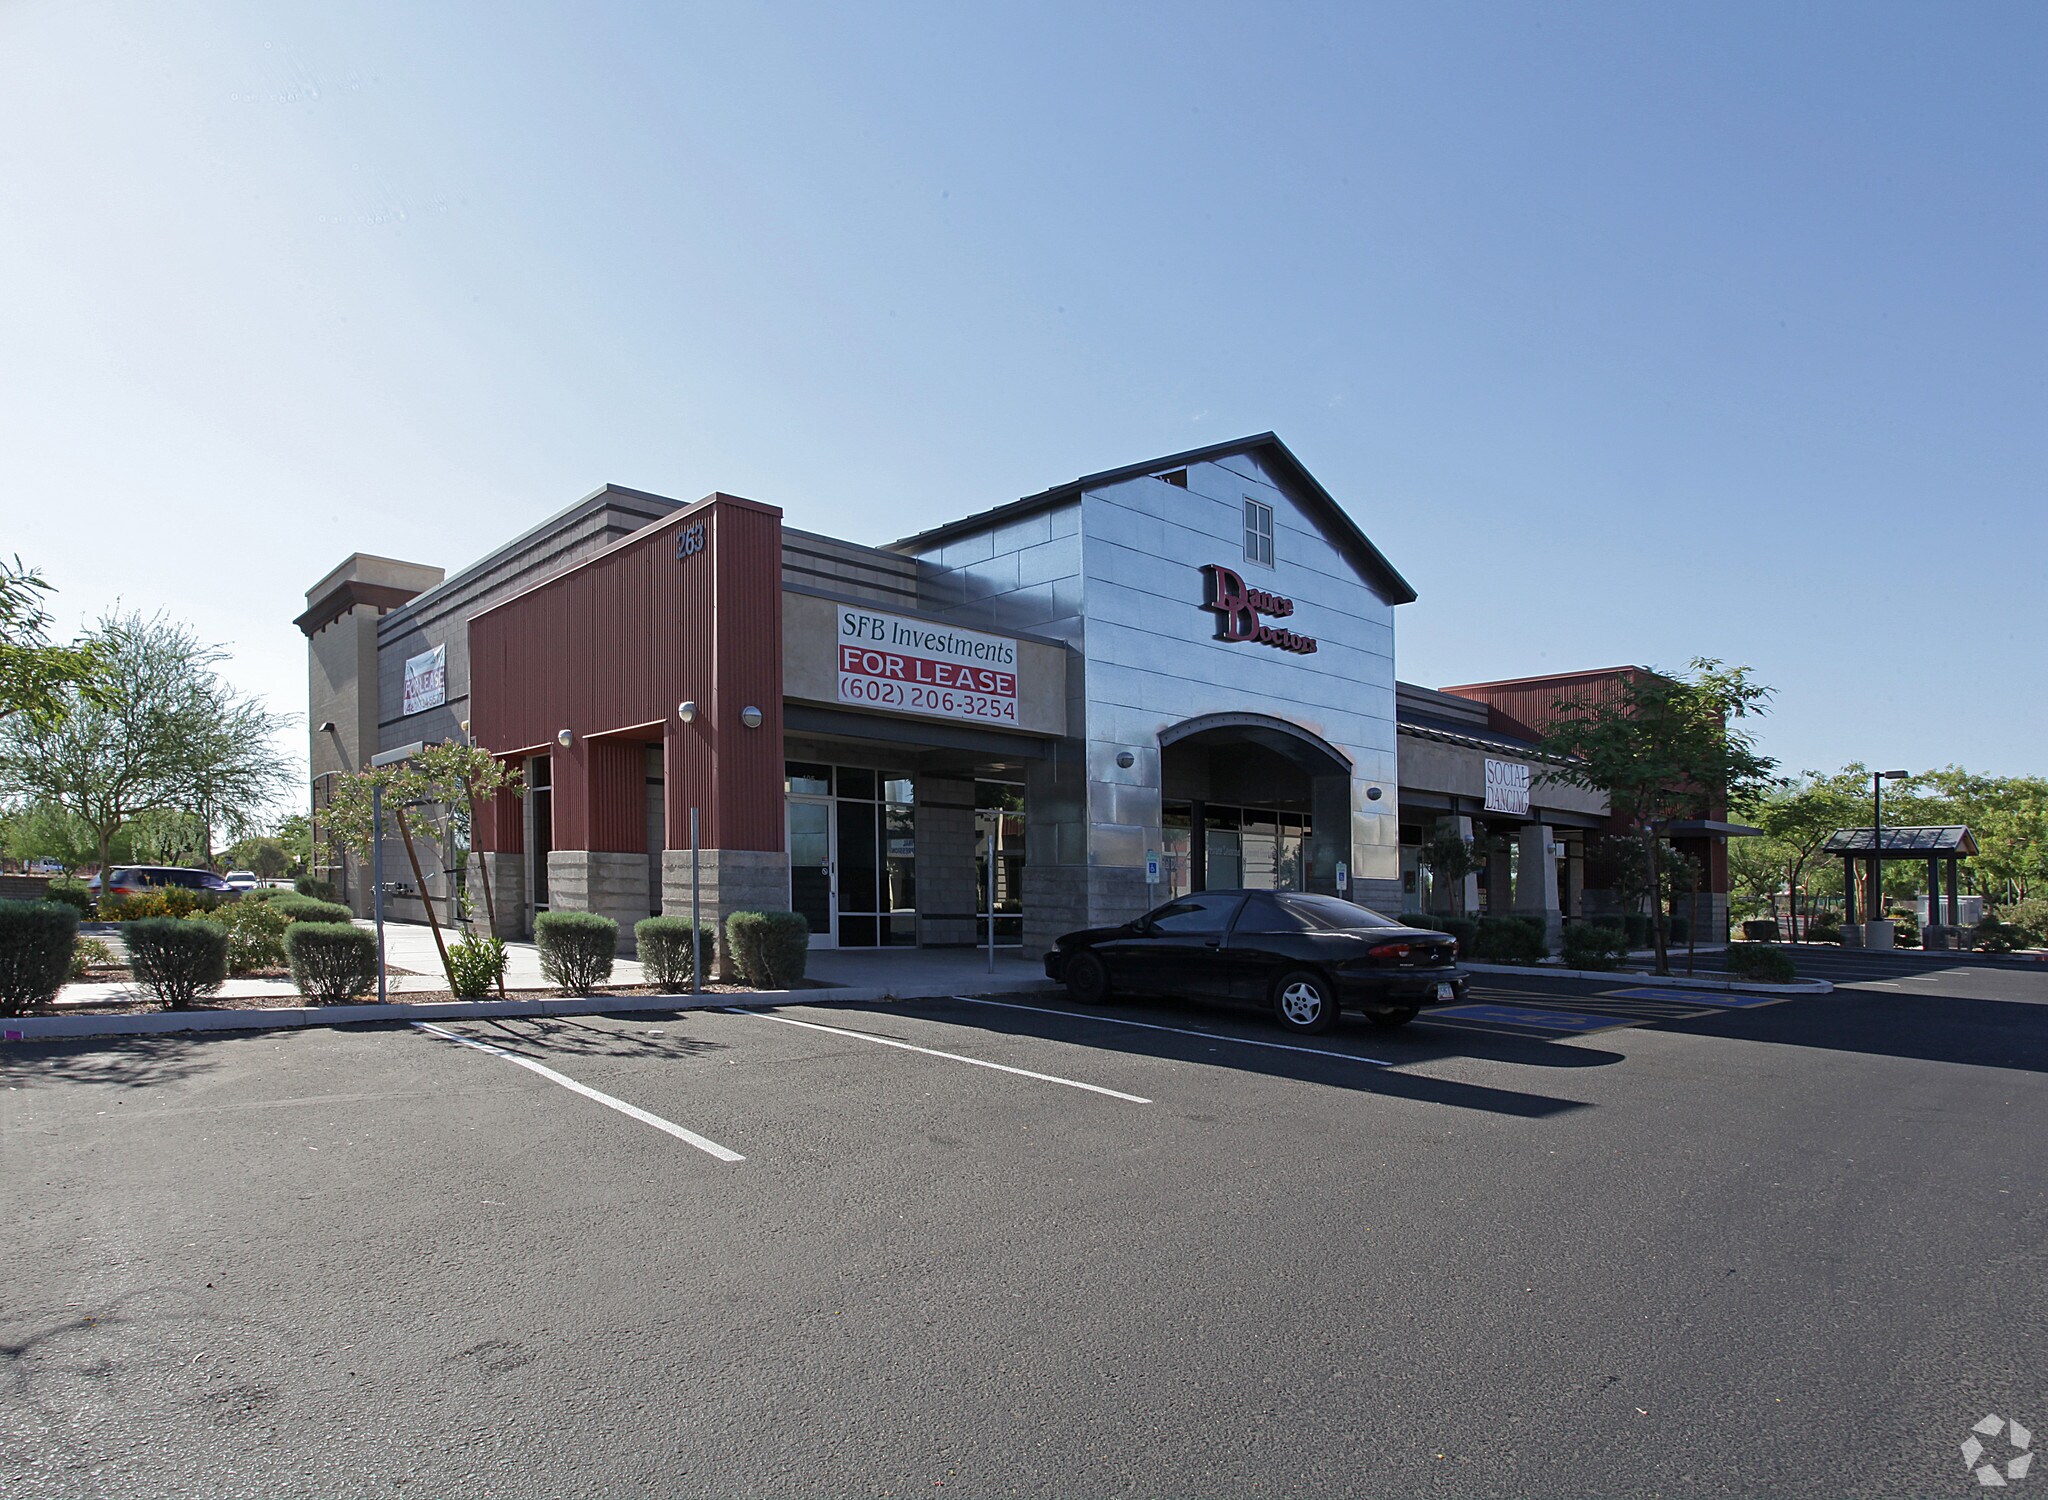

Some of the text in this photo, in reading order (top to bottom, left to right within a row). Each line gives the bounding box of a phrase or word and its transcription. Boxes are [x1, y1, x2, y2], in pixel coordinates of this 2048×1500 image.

[676, 523, 704, 560] 263
[1210, 564, 1294, 616] Dance
[842, 613, 1013, 664] SFB Investments
[1224, 595, 1318, 653] Doctors
[420, 666, 444, 693] LEASE
[843, 648, 1013, 695] FOR LEASE
[841, 677, 1015, 720] (602) 206-3254
[1487, 761, 1528, 788] SOCIAL
[1486, 786, 1528, 813] DANCING
